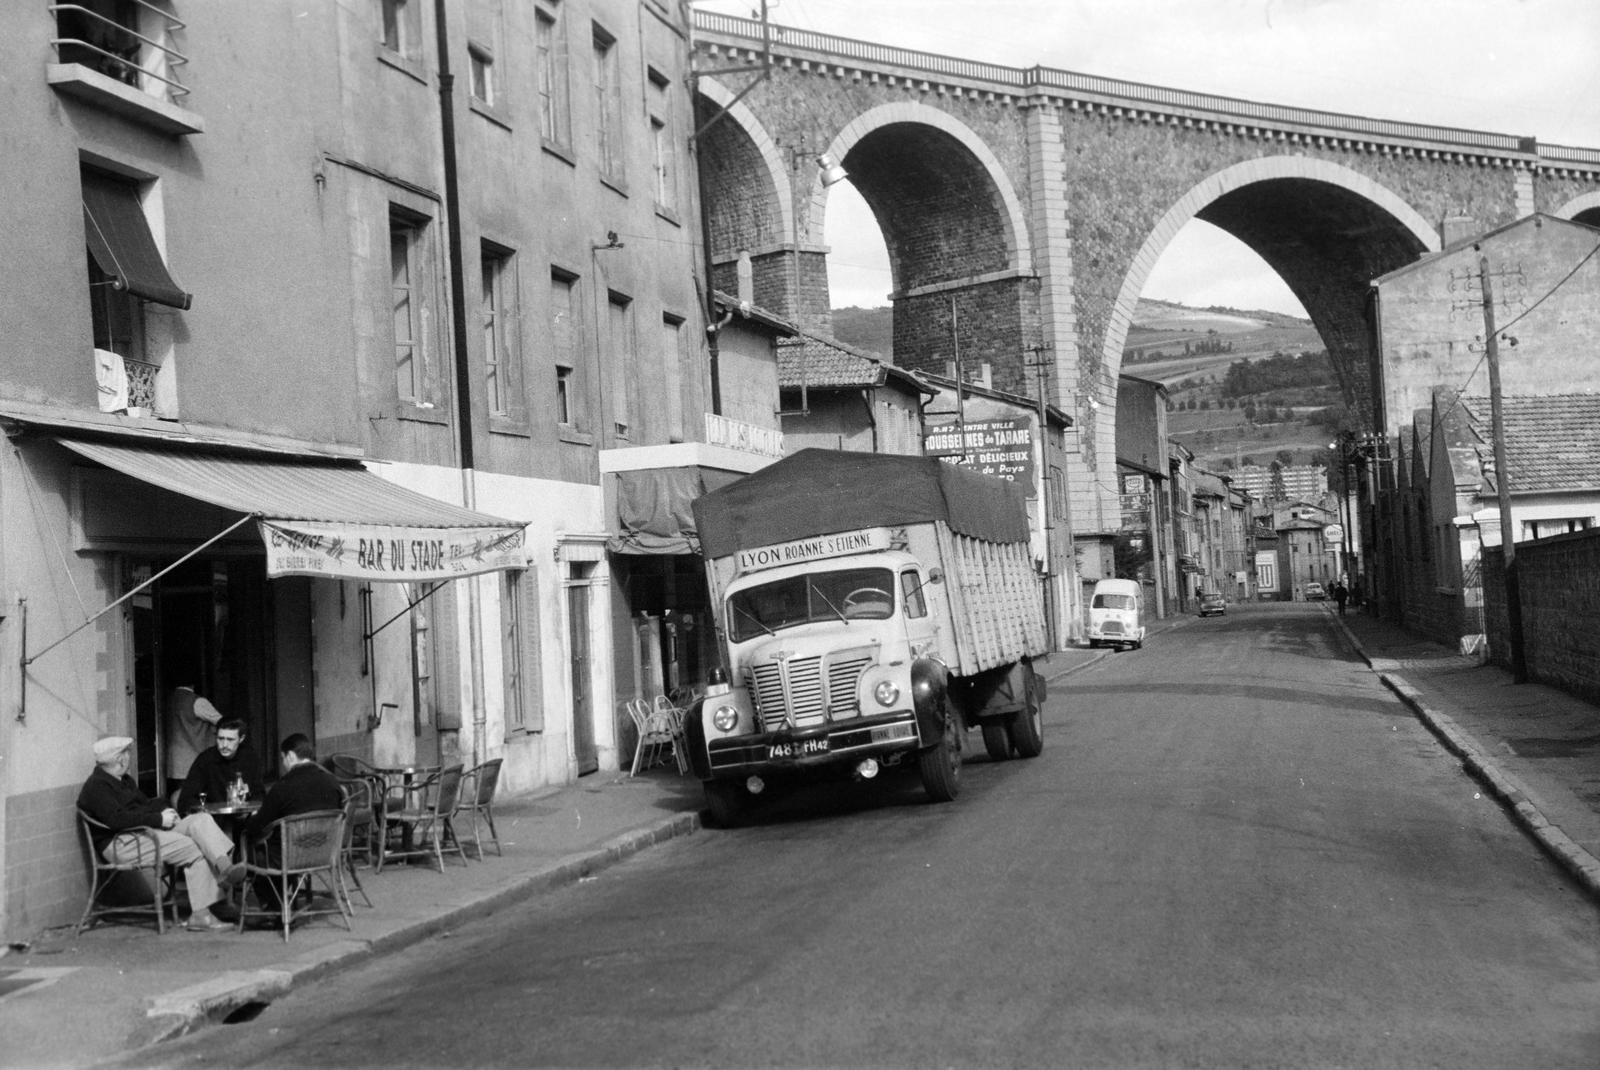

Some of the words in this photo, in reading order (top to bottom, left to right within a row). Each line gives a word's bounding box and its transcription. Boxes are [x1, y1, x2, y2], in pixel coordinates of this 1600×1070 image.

[958, 423, 988, 431] ENTRE
[991, 421, 1014, 429] VILLE
[985, 434, 994, 444] de
[994, 429, 1031, 446] TARARE
[982, 465, 994, 474] du
[999, 464, 1025, 474] Pays
[358, 538, 386, 571] BAR
[391, 539, 404, 572] DU
[411, 540, 444, 572] STADE
[741, 548, 782, 568] LYON
[784, 542, 824, 560] ROANNE
[836, 533, 873, 552] ETIENNE
